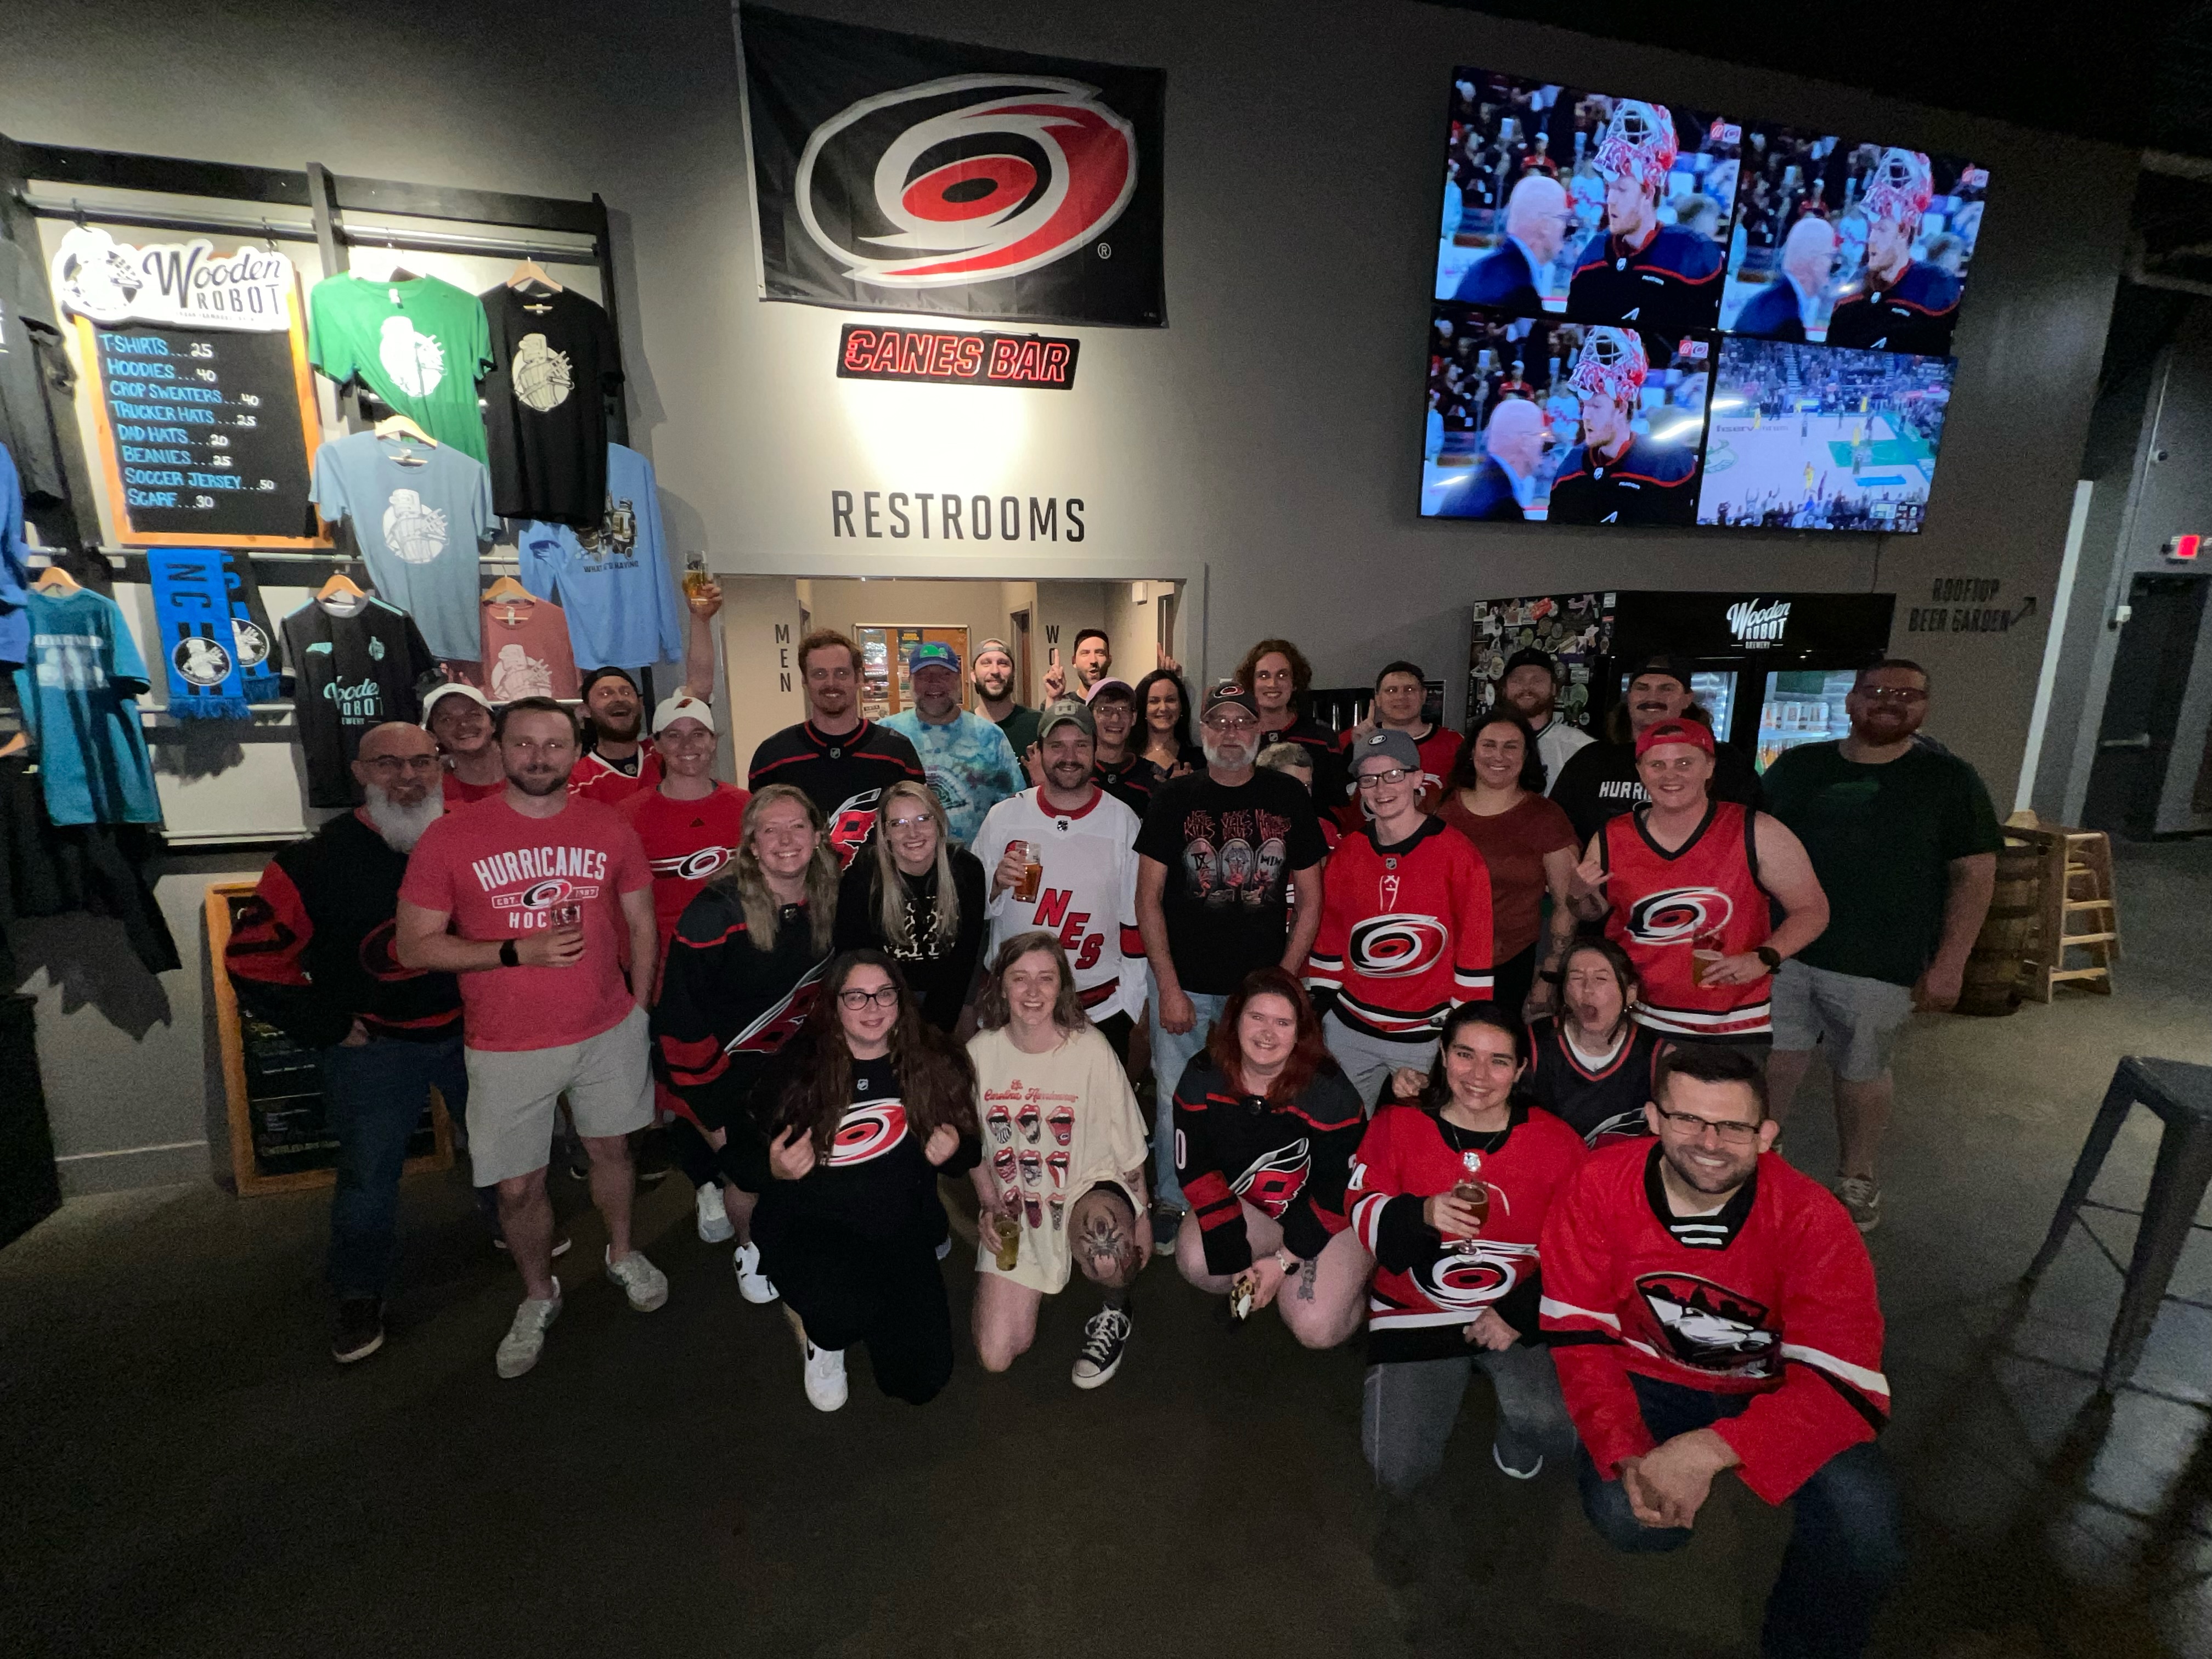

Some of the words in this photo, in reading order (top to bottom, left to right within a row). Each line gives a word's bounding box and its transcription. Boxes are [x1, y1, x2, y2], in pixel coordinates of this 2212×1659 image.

[142, 246, 280, 308] Wooden
[197, 283, 280, 315] ROBOT
[191, 342, 214, 358] 25
[844, 330, 983, 376] CANES
[988, 340, 1068, 382] BAR
[106, 358, 175, 380] HOODIES
[196, 368, 216, 382] 40
[110, 380, 146, 398] CROP
[241, 393, 260, 407] 40
[110, 399, 176, 421] TRUCKER
[176, 406, 216, 424] HATS
[236, 414, 256, 427] 25
[117, 423, 145, 441] DAD
[146, 426, 189, 444] HATS
[121, 445, 191, 465] BEANIES
[124, 466, 184, 486] SOCCER
[187, 472, 242, 490] JERSEY
[259, 479, 275, 490] 50
[127, 488, 178, 507] SCARF
[195, 495, 214, 508] 30
[832, 490, 1085, 543] RESTROOMS
[1932, 578, 2000, 602] ROOFTOP
[1726, 597, 1792, 641] Wooden
[1746, 617, 1787, 640] ROBOT
[1908, 608, 1948, 632] BEER
[1951, 608, 2012, 633] GARDEN
[775, 624, 792, 692] MEN
[1184, 821, 1216, 839] KILLS
[472, 846, 607, 892] HURRICANES
